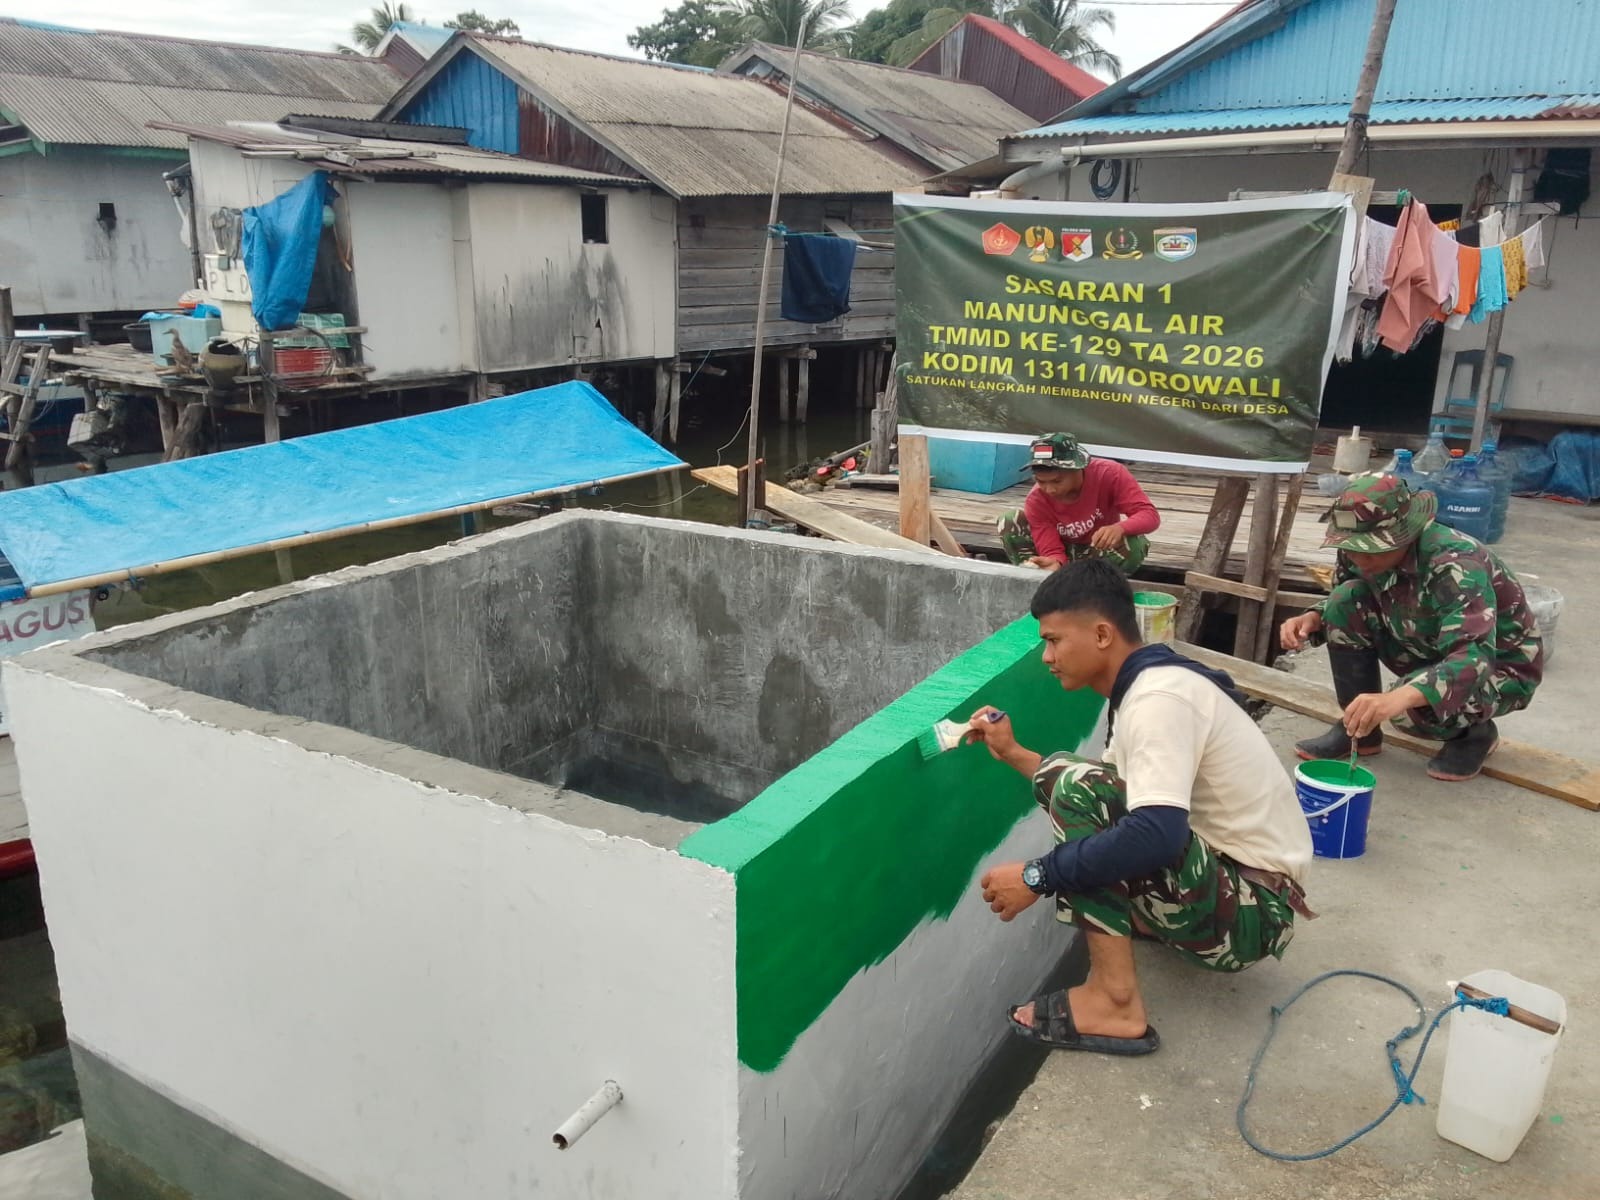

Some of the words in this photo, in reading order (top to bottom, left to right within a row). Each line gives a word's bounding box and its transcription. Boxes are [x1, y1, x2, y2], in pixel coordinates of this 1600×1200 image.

[1005, 274, 1144, 303] SASARAN
[1158, 283, 1172, 304] 1
[964, 301, 1152, 334] MANUNGGAL
[1164, 314, 1224, 336] AIR
[929, 325, 1011, 348] TMMD
[1020, 332, 1122, 357] KE-129
[1129, 342, 1169, 364] TA
[1181, 344, 1264, 368] 2026
[906, 374, 966, 388] SATUKAN
[970, 380, 1036, 394] LANGKAH
[1040, 385, 1132, 404] MEMBANGUN
[1138, 393, 1196, 409] NEGERI
[1201, 401, 1237, 414] DARI
[1243, 403, 1289, 415] DESA
[923, 351, 1013, 376] KODIM
[1024, 359, 1281, 398] 1311/MOROWALI
[0, 592, 90, 642] AGUS
